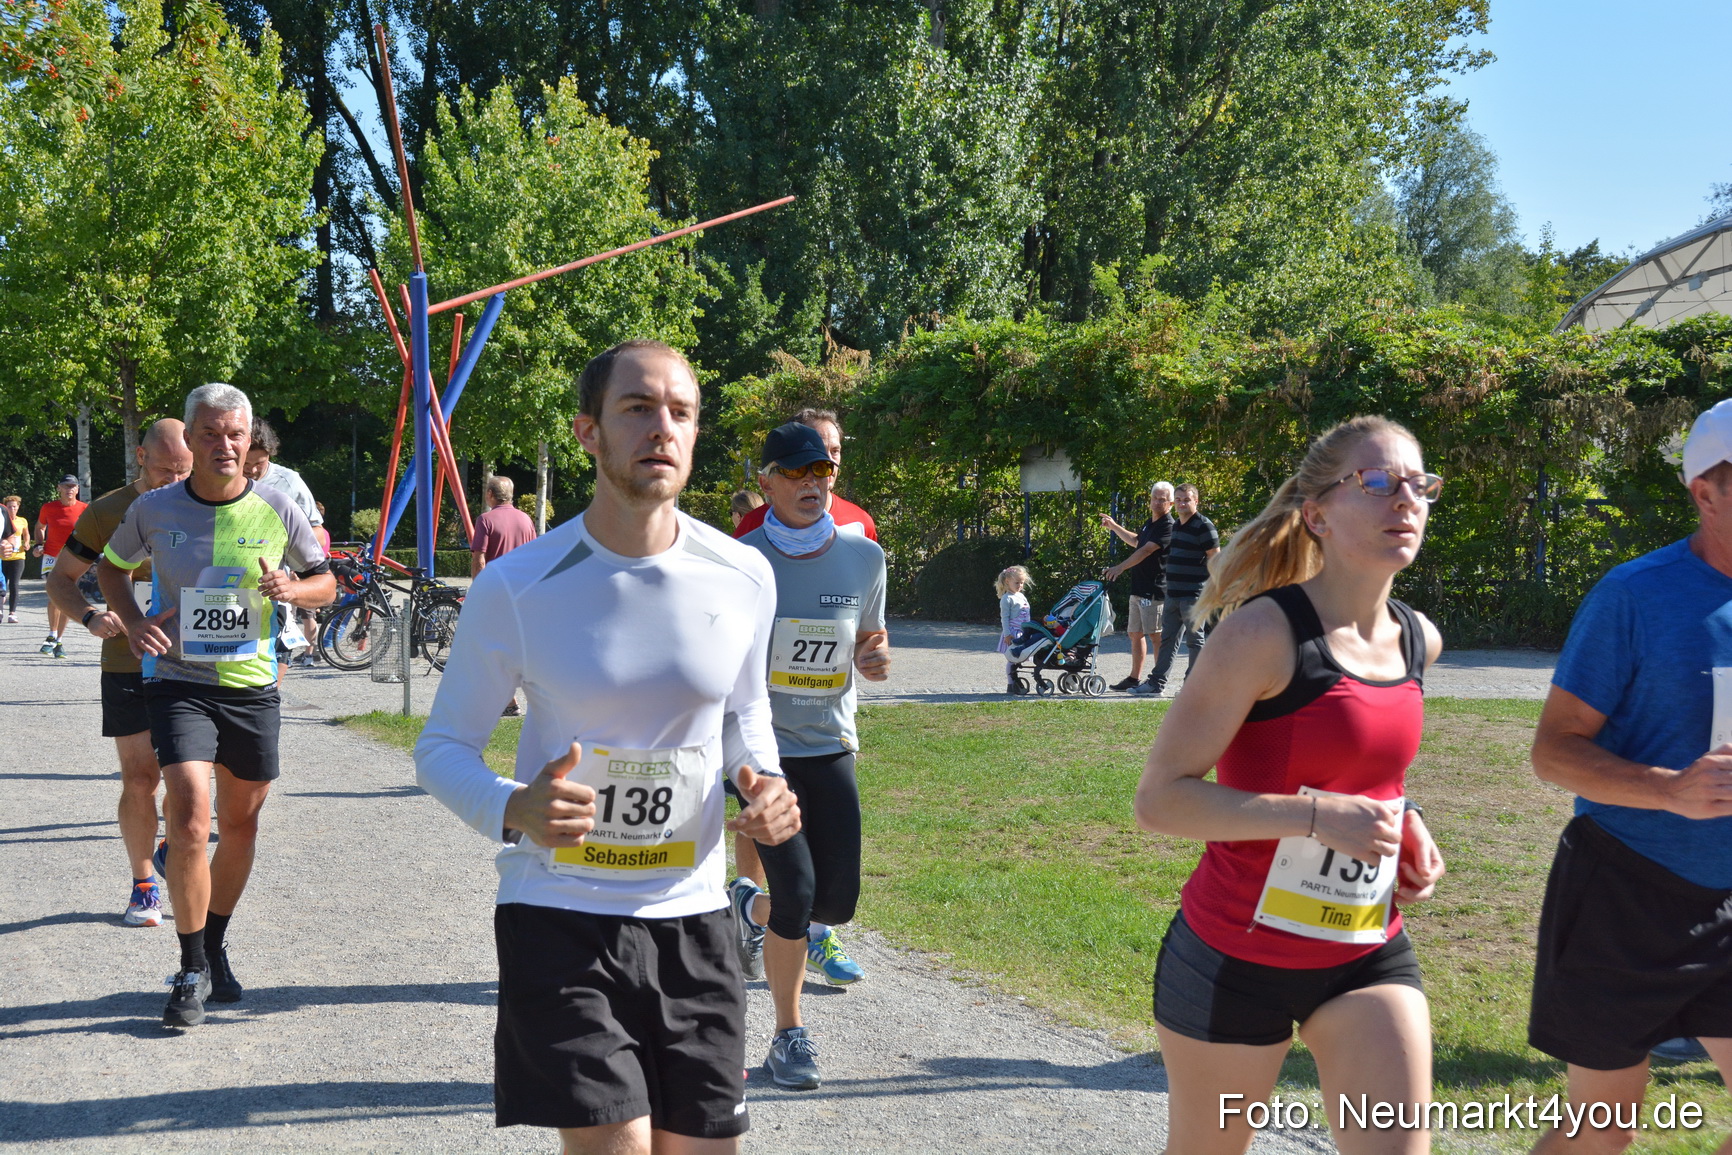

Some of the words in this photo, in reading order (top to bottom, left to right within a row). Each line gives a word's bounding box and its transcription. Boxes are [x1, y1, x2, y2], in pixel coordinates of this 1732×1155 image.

[820, 595, 859, 606] BOCK
[193, 608, 249, 630] 2894
[799, 625, 835, 634] BOCK
[205, 644, 238, 653] Werner
[792, 640, 837, 663] 277
[789, 676, 833, 688] Wolfgang
[608, 760, 672, 775] BOCK
[598, 784, 673, 826] 138
[587, 829, 618, 839] PARTL
[620, 832, 661, 840] Neumarkt
[584, 846, 668, 866] Sebastian
[1281, 858, 1287, 866] D
[1301, 880, 1331, 895] PARTL
[1334, 889, 1368, 899] Neumarkt
[1320, 905, 1352, 926] Tina
